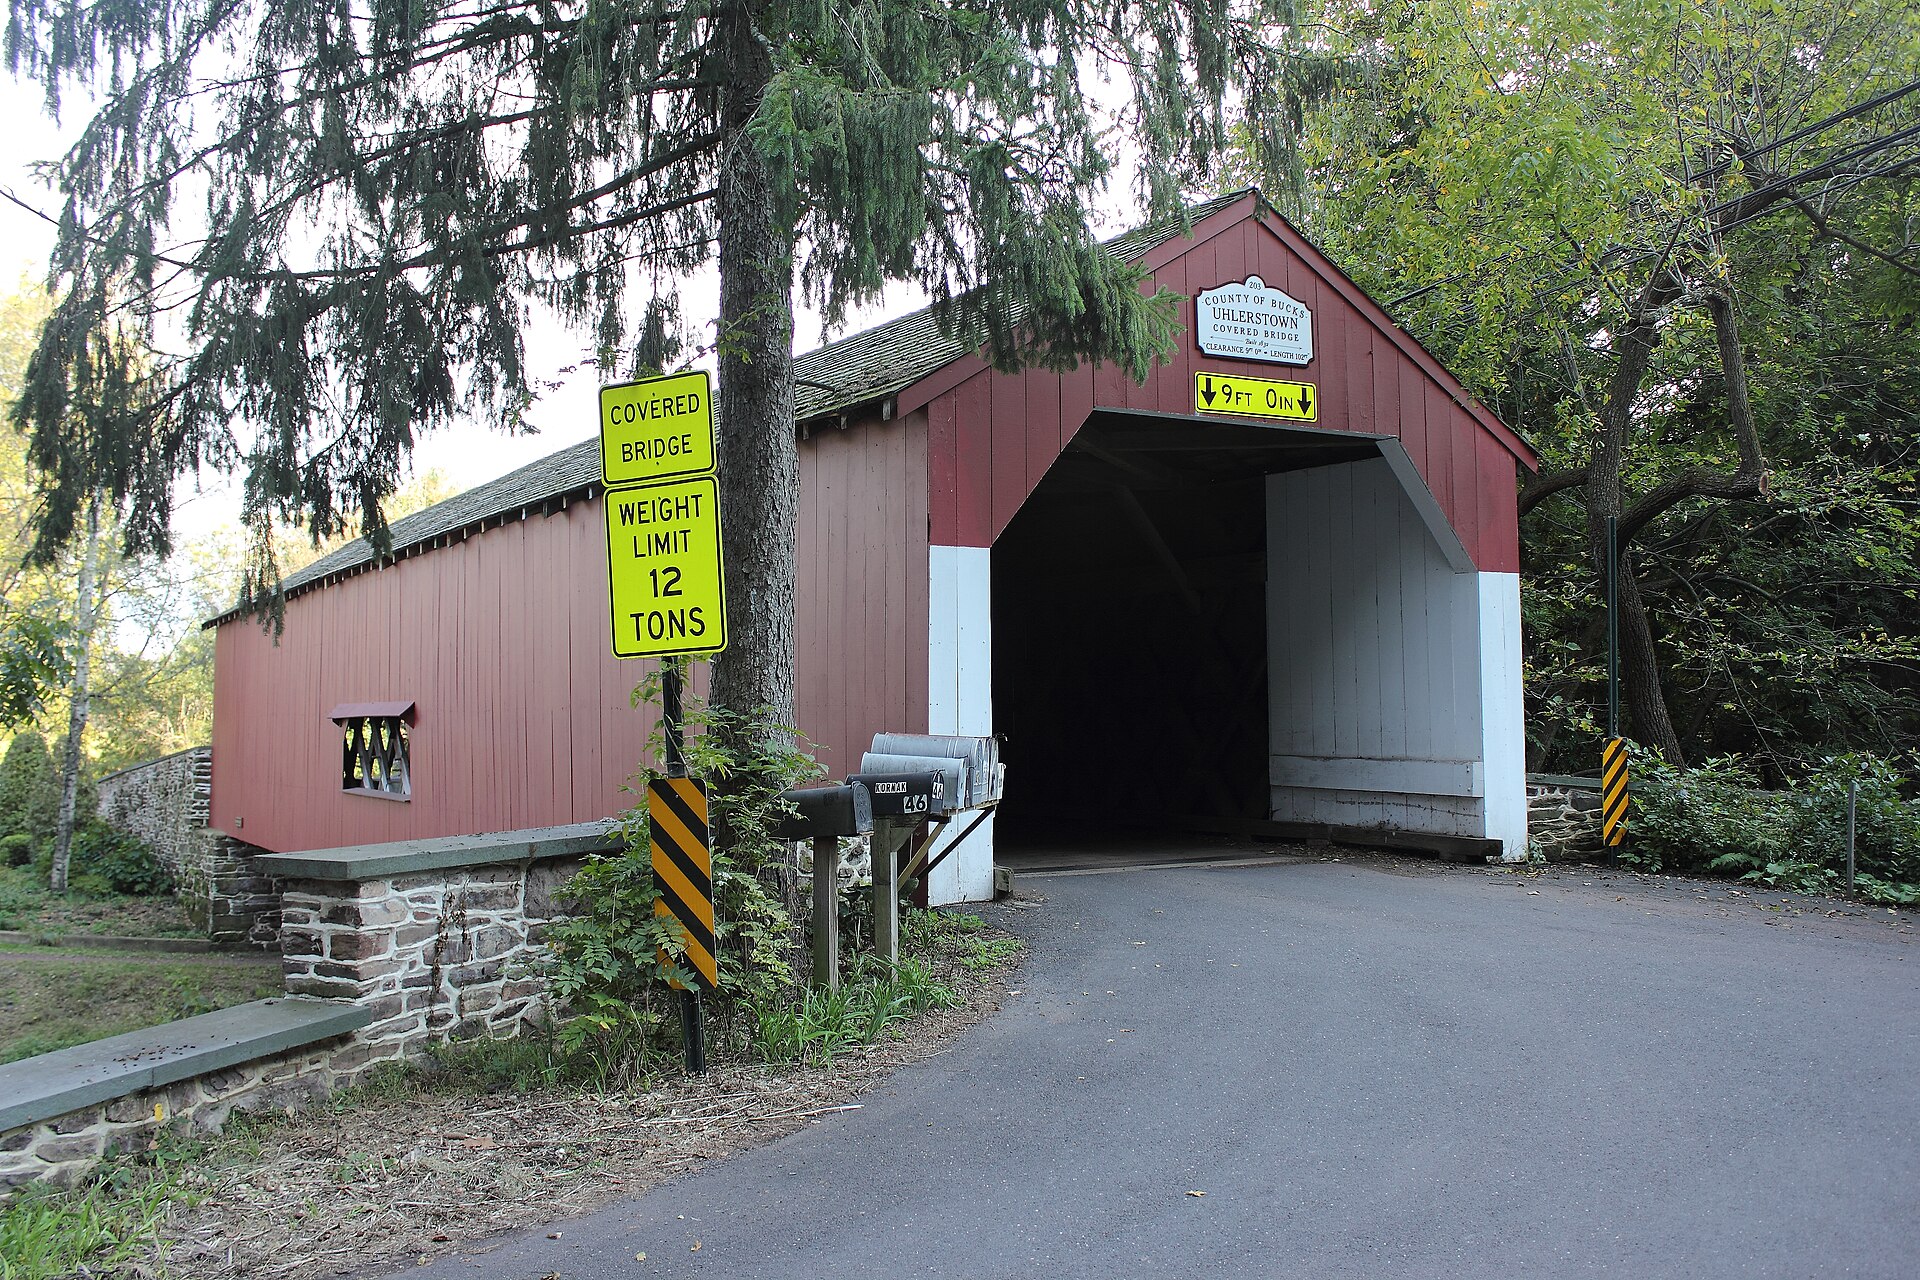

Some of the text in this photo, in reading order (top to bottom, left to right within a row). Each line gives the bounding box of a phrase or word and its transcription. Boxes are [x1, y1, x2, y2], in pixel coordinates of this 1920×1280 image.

[1249, 281, 1261, 290] 203
[1205, 294, 1305, 319] COUNTY OF BUCKS
[1212, 307, 1298, 329] UHLERSTOWN
[1213, 324, 1299, 341] COVERED BRIDGE
[1205, 342, 1243, 353] CLEARANCE
[1270, 350, 1294, 359] LENGTH
[611, 393, 700, 425] COVERED
[622, 434, 692, 462] BRIDGE
[619, 494, 702, 526] WEIGHT
[633, 529, 691, 558] LIMIT
[649, 566, 682, 598] 12
[630, 607, 706, 641] TONS
[904, 795, 927, 812] 46
